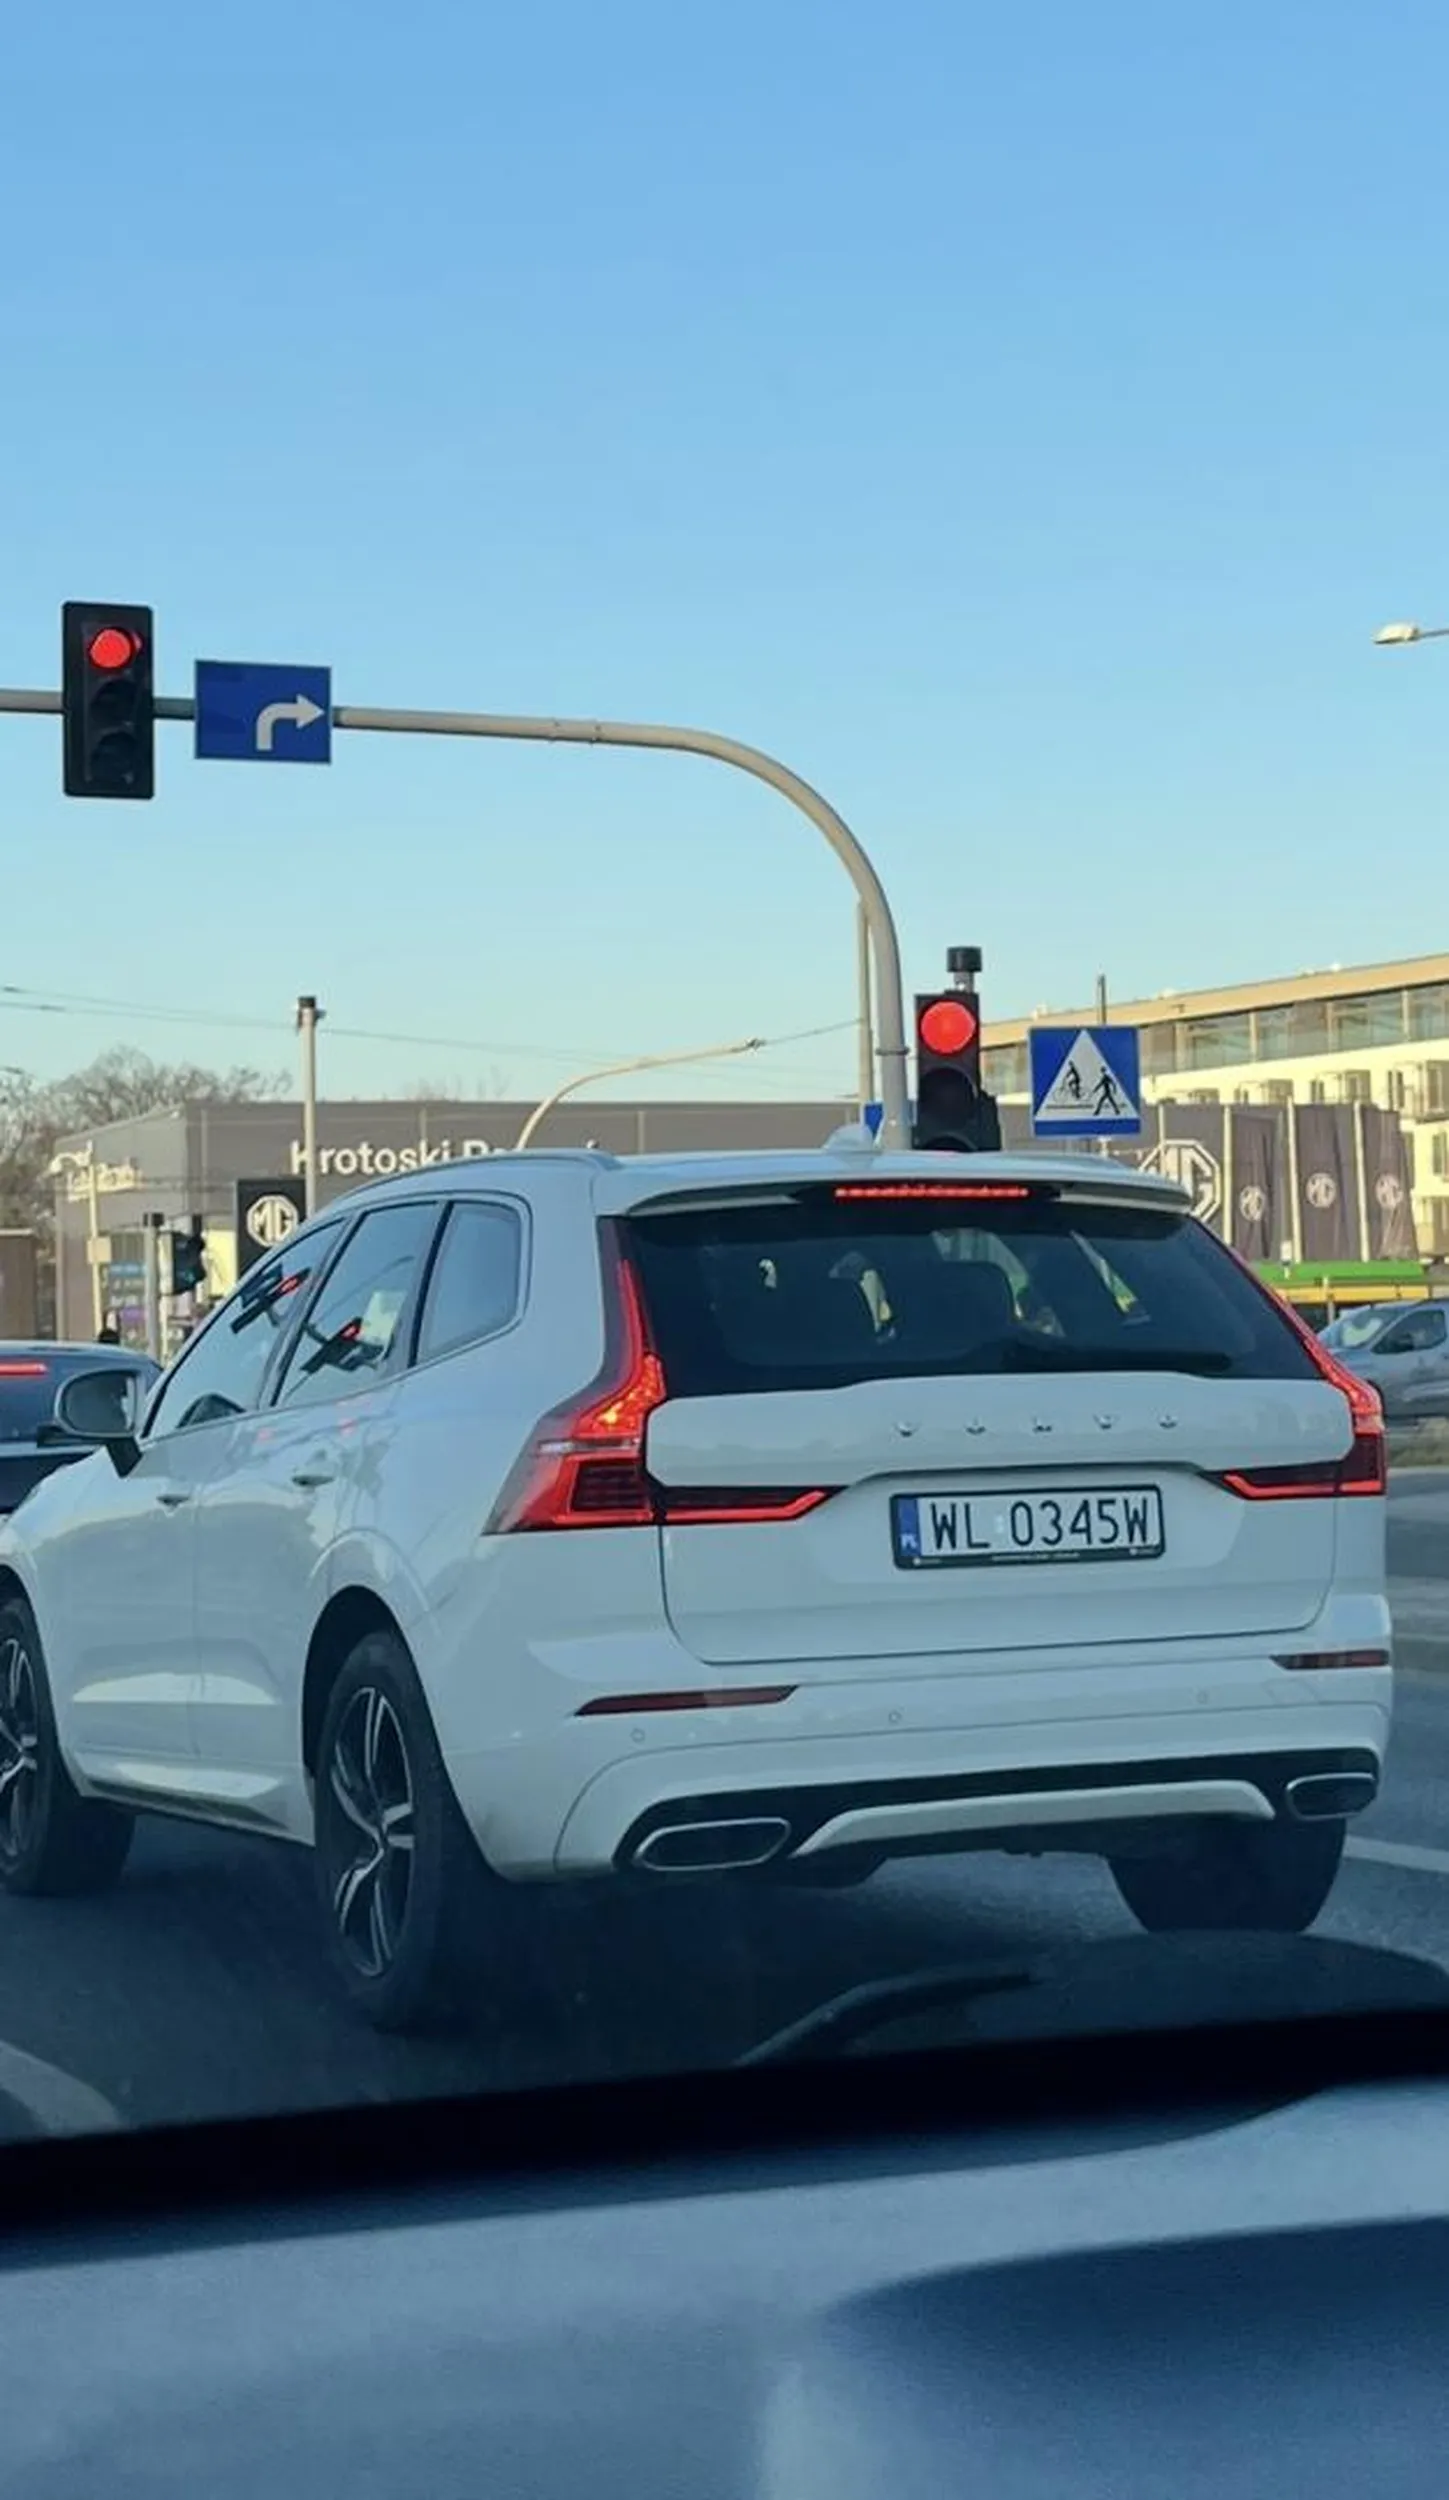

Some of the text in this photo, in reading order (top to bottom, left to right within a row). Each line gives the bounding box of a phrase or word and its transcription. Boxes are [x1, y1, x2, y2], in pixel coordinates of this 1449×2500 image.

[251, 1198, 295, 1244] MG
[930, 1497, 1148, 1550] WL 0345W
